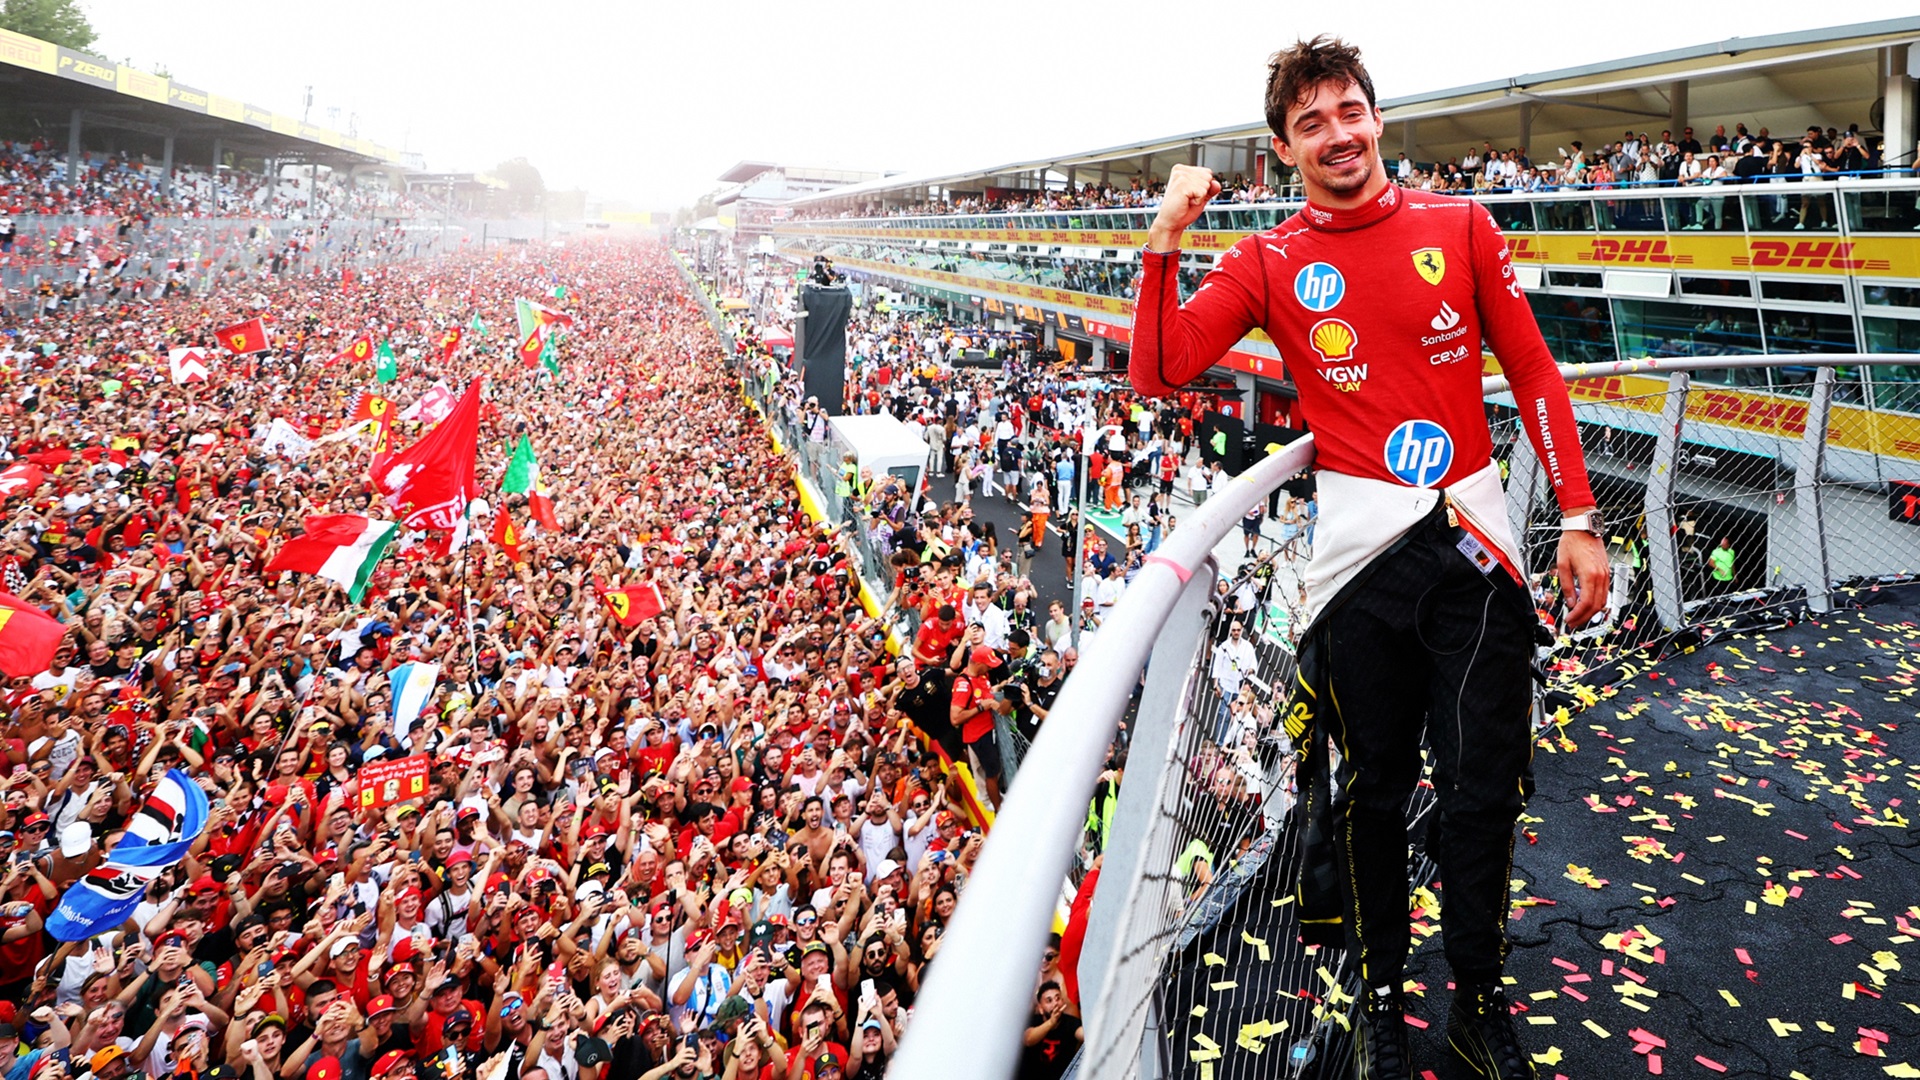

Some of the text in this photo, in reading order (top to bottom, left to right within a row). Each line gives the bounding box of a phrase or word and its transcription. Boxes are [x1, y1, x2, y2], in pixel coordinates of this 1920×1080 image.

[59, 56, 115, 82] P ZERO
[1191, 234, 1220, 248] DHL
[1591, 240, 1675, 263] DHL
[1750, 241, 1866, 269] DHL
[1302, 263, 1339, 311] hp
[1421, 325, 1467, 347] Santander
[1317, 363, 1368, 382] VGW
[1704, 393, 1807, 433] DHL
[1395, 421, 1446, 487] hp
[1535, 397, 1563, 487] RICHARD MILLE
[1345, 820, 1368, 959] TRADITION AND INNOVAON
